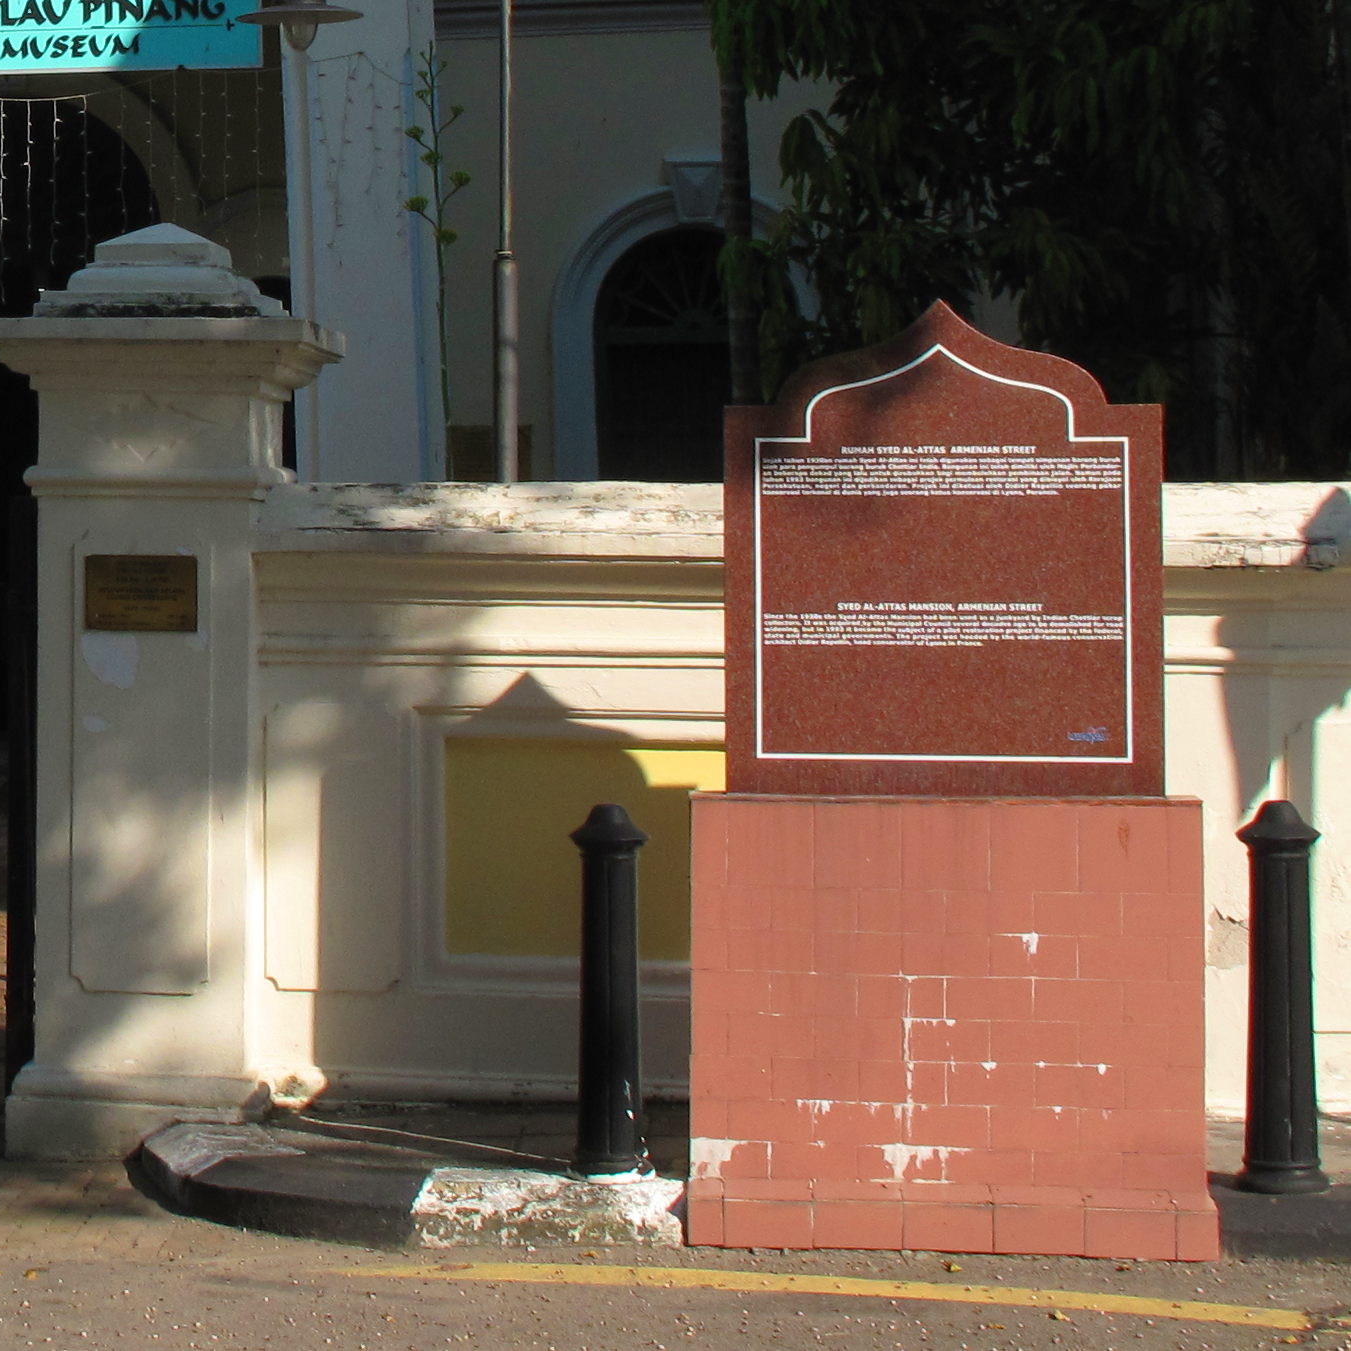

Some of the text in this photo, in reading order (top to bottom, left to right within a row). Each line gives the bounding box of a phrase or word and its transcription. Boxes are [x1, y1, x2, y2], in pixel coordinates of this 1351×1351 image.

[0, 33, 140, 61] MUSEUM
[841, 446, 1036, 455] RUMAH SYED AL-ATTAS ARMENIAN STREET
[837, 603, 1043, 613] SYED AL-ATTAS MANSION, ARMENIAN STREET
